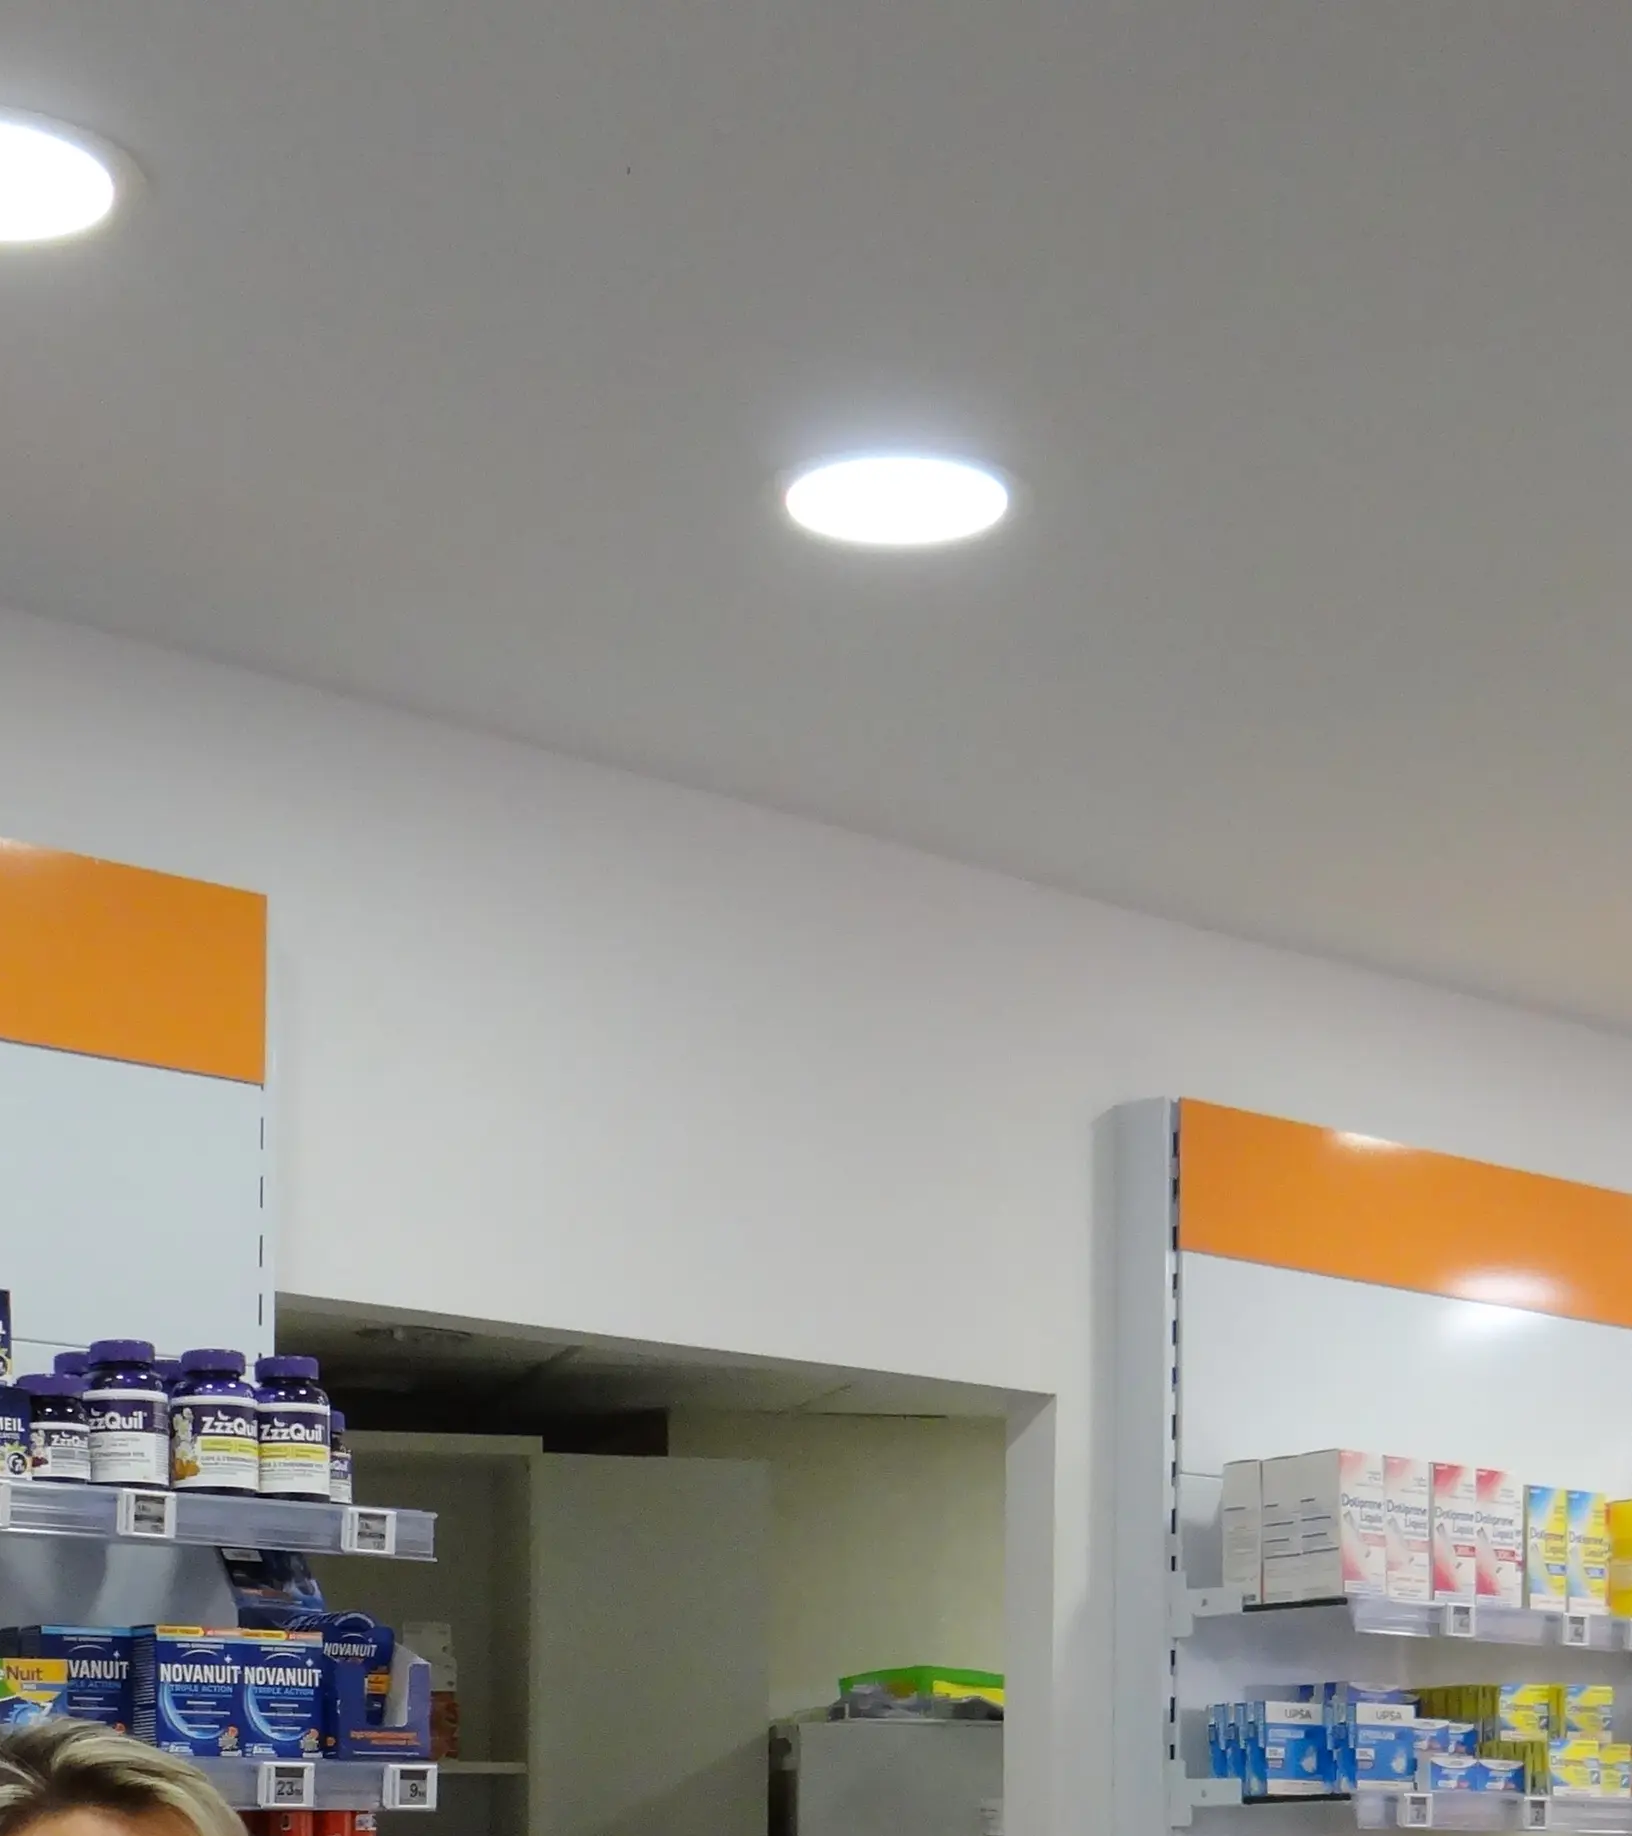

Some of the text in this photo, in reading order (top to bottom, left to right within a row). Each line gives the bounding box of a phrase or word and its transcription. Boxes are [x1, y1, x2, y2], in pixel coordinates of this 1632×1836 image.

[89, 1410, 148, 1431] zzQuil
[202, 1412, 258, 1436] ZzzQui
[261, 1419, 326, 1442] ZzzQuil
[324, 1642, 377, 1658] NOVANUIT
[6, 1665, 42, 1682] Nuit
[160, 1663, 241, 1684] NOVANUIT
[244, 1666, 322, 1687] NOVANUIT
[204, 1686, 233, 1694] ACTION
[284, 1687, 314, 1696] ACTION
